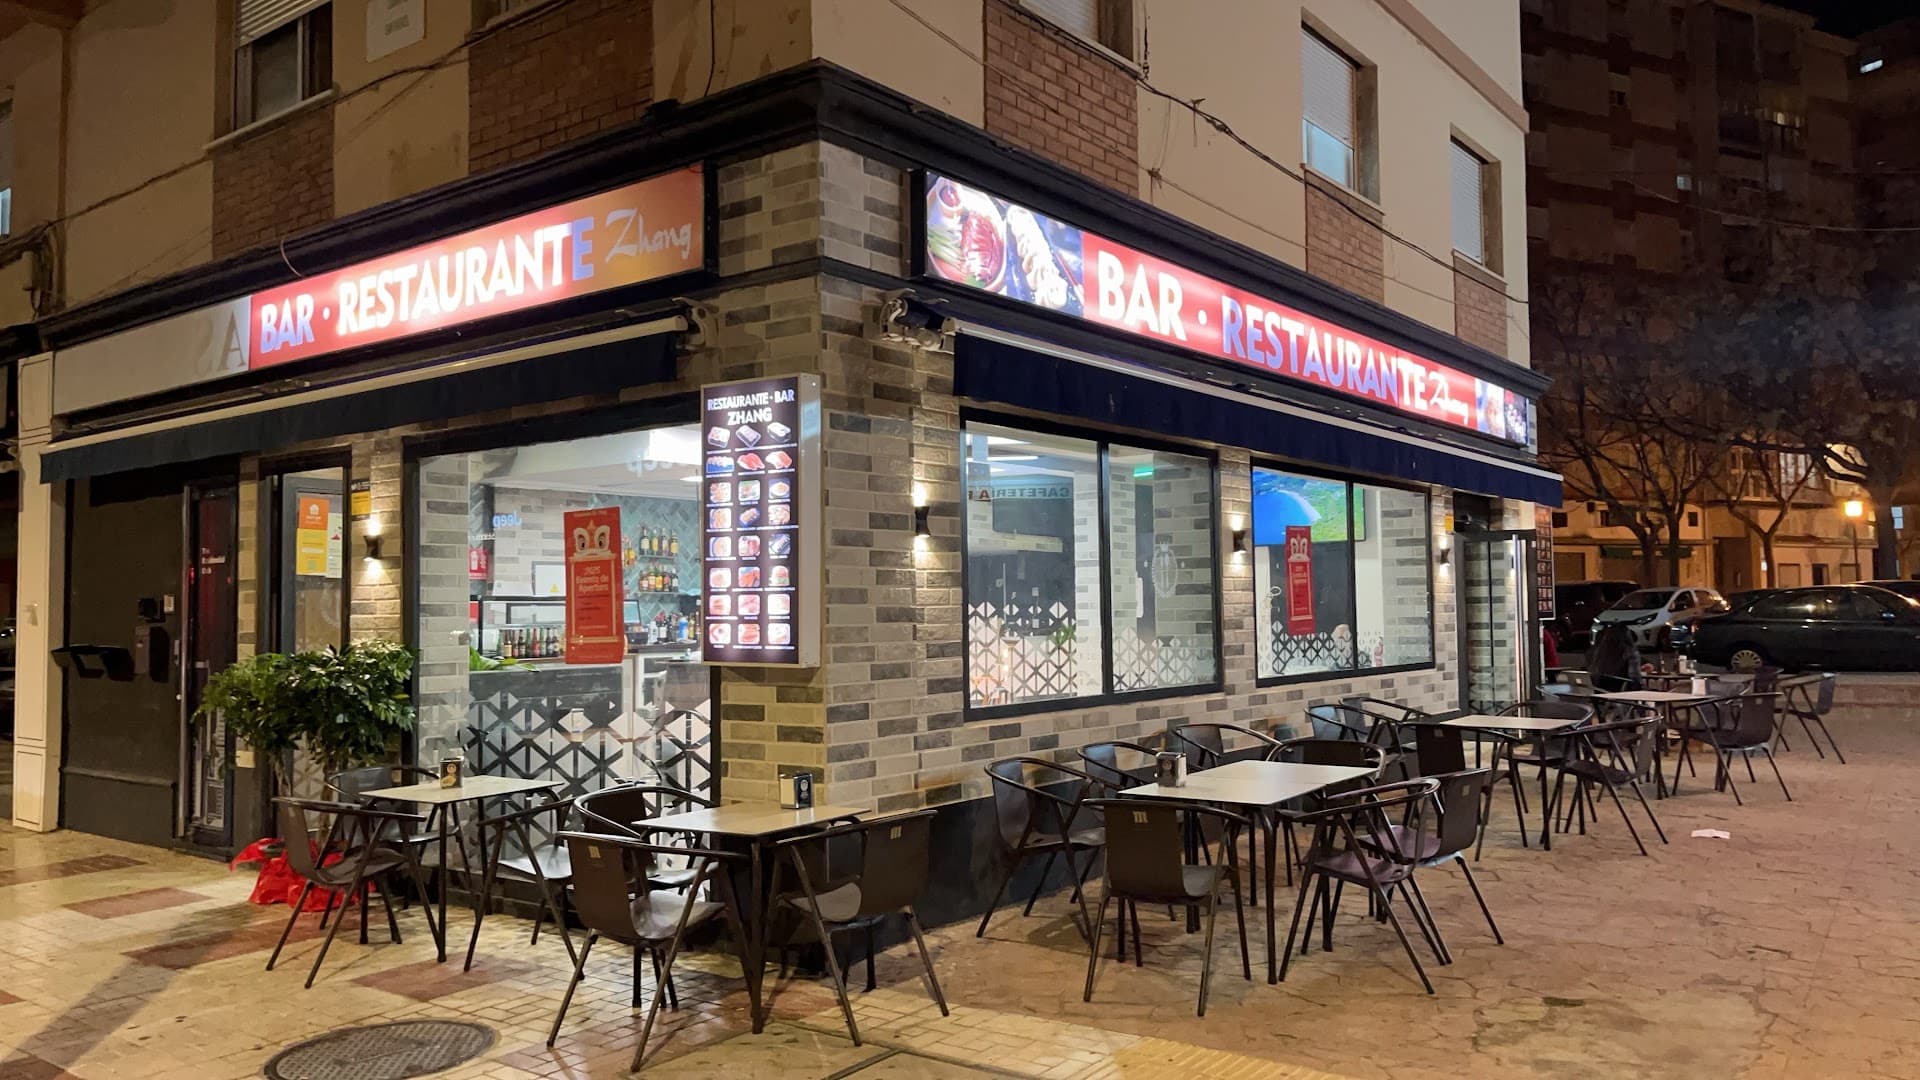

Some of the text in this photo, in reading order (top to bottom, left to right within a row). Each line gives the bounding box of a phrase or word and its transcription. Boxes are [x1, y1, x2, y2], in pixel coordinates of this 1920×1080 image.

[261, 208, 692, 353] BAR RESTAURANTE Zhang
[1098, 251, 1187, 341] BAR
[1221, 295, 1425, 411] RESTAURANTE
[707, 389, 795, 411] RESTAURANTE BAR
[727, 407, 773, 425] ZHANG
